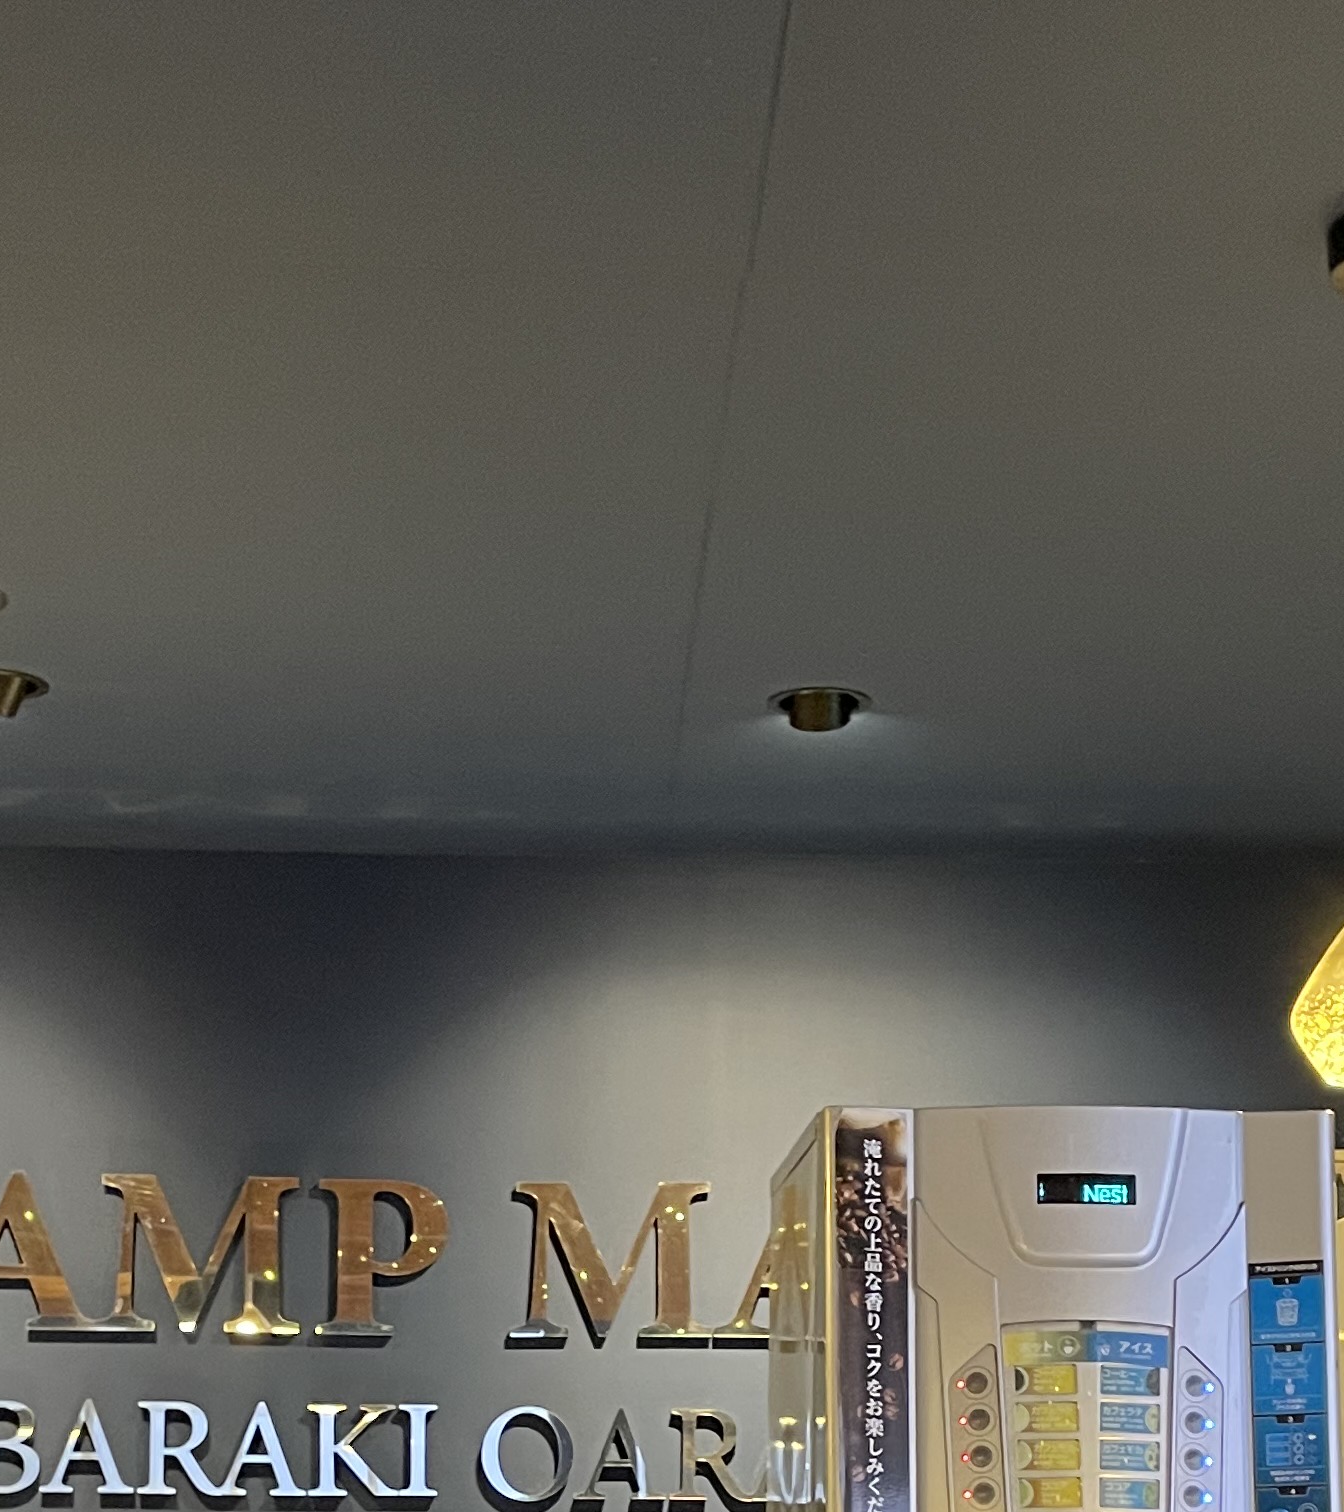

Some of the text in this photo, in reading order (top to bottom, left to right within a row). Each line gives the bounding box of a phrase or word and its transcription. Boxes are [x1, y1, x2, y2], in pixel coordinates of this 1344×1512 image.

[1118, 1340, 1153, 1354] アイス
[478, 1404, 769, 1512] OAR
